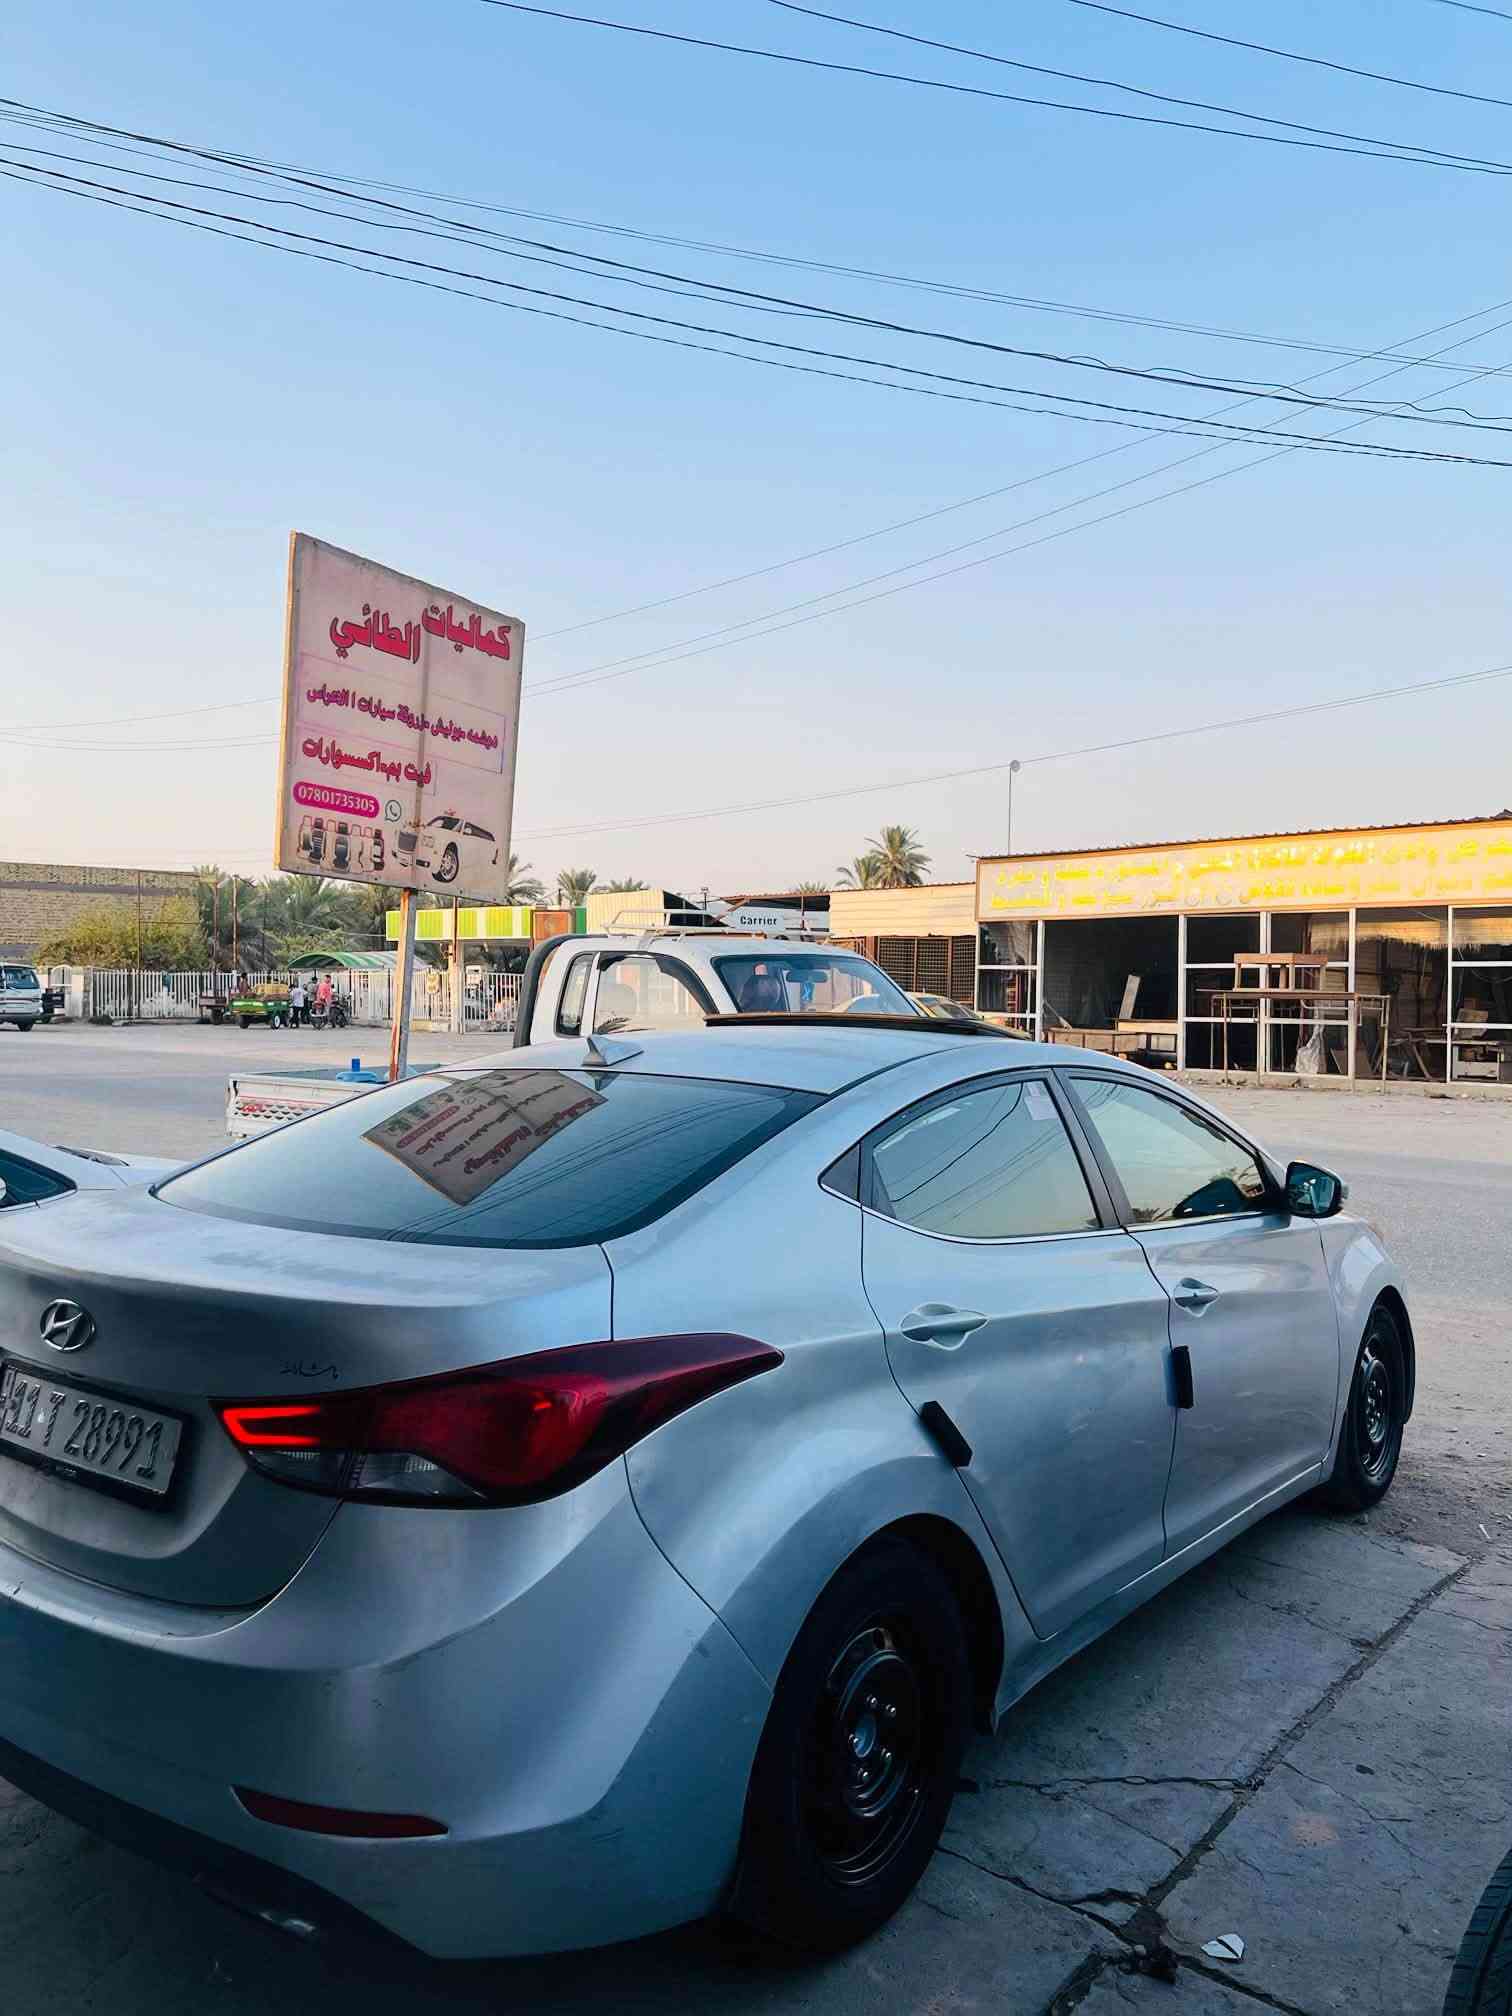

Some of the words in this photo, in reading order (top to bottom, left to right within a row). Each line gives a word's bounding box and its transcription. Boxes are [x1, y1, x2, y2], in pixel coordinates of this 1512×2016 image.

[330, 603, 421, 664] الطائي
[421, 605, 512, 660] كماليات
[358, 696, 396, 721] سيارات
[298, 785, 375, 813] 07801735305
[740, 916, 777, 925] Carrier
[64, 1399, 164, 1480] 28991
